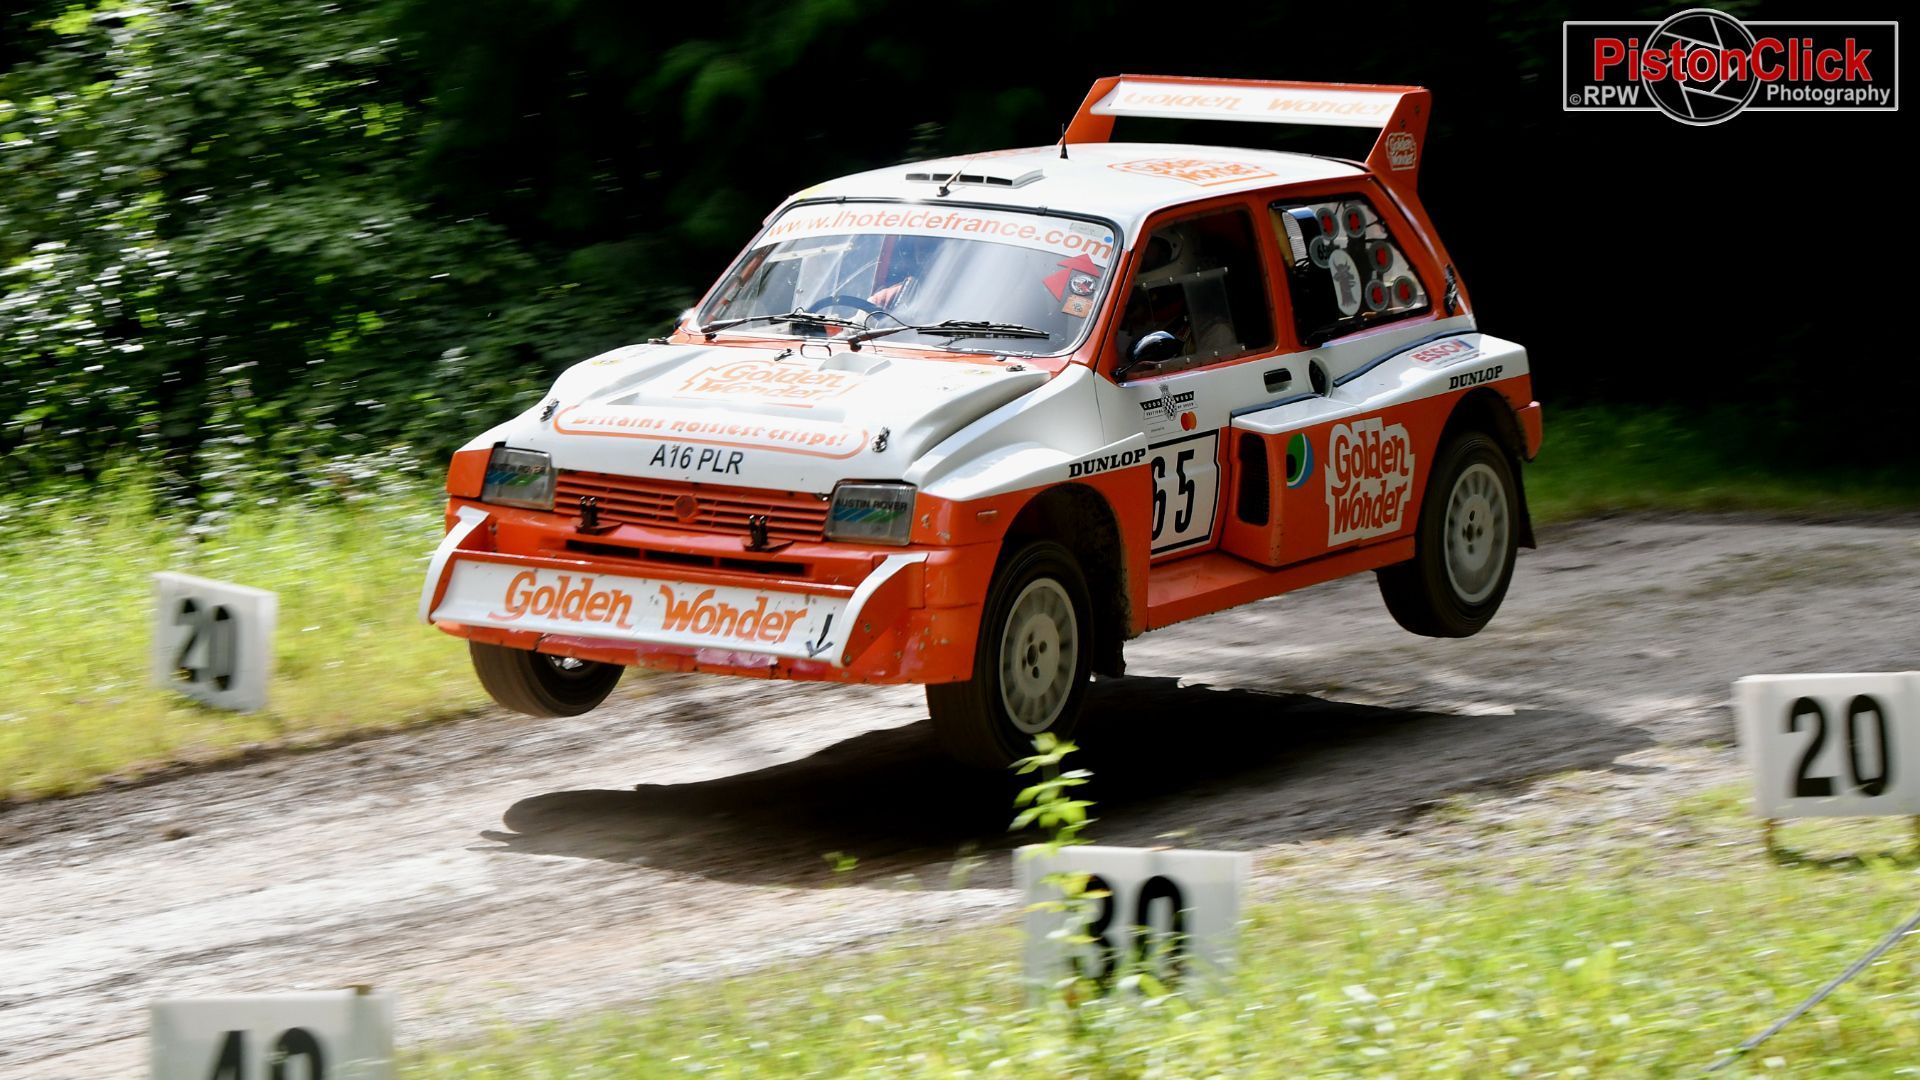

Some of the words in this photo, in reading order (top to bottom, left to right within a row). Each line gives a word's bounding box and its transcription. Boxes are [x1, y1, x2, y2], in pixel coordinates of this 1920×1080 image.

[694, 378, 832, 399] Wonder
[709, 363, 846, 387] Golden
[1449, 365, 1503, 390] DUNLOP
[649, 443, 693, 469] A16
[696, 449, 744, 475] PLR
[1069, 448, 1146, 477] DUNLOP
[1334, 430, 1410, 489] Golden
[1332, 479, 1408, 535] Wonder
[487, 570, 635, 630] Golden
[658, 584, 809, 643] Wonder
[174, 597, 238, 693] 20
[1784, 694, 1890, 798] 20
